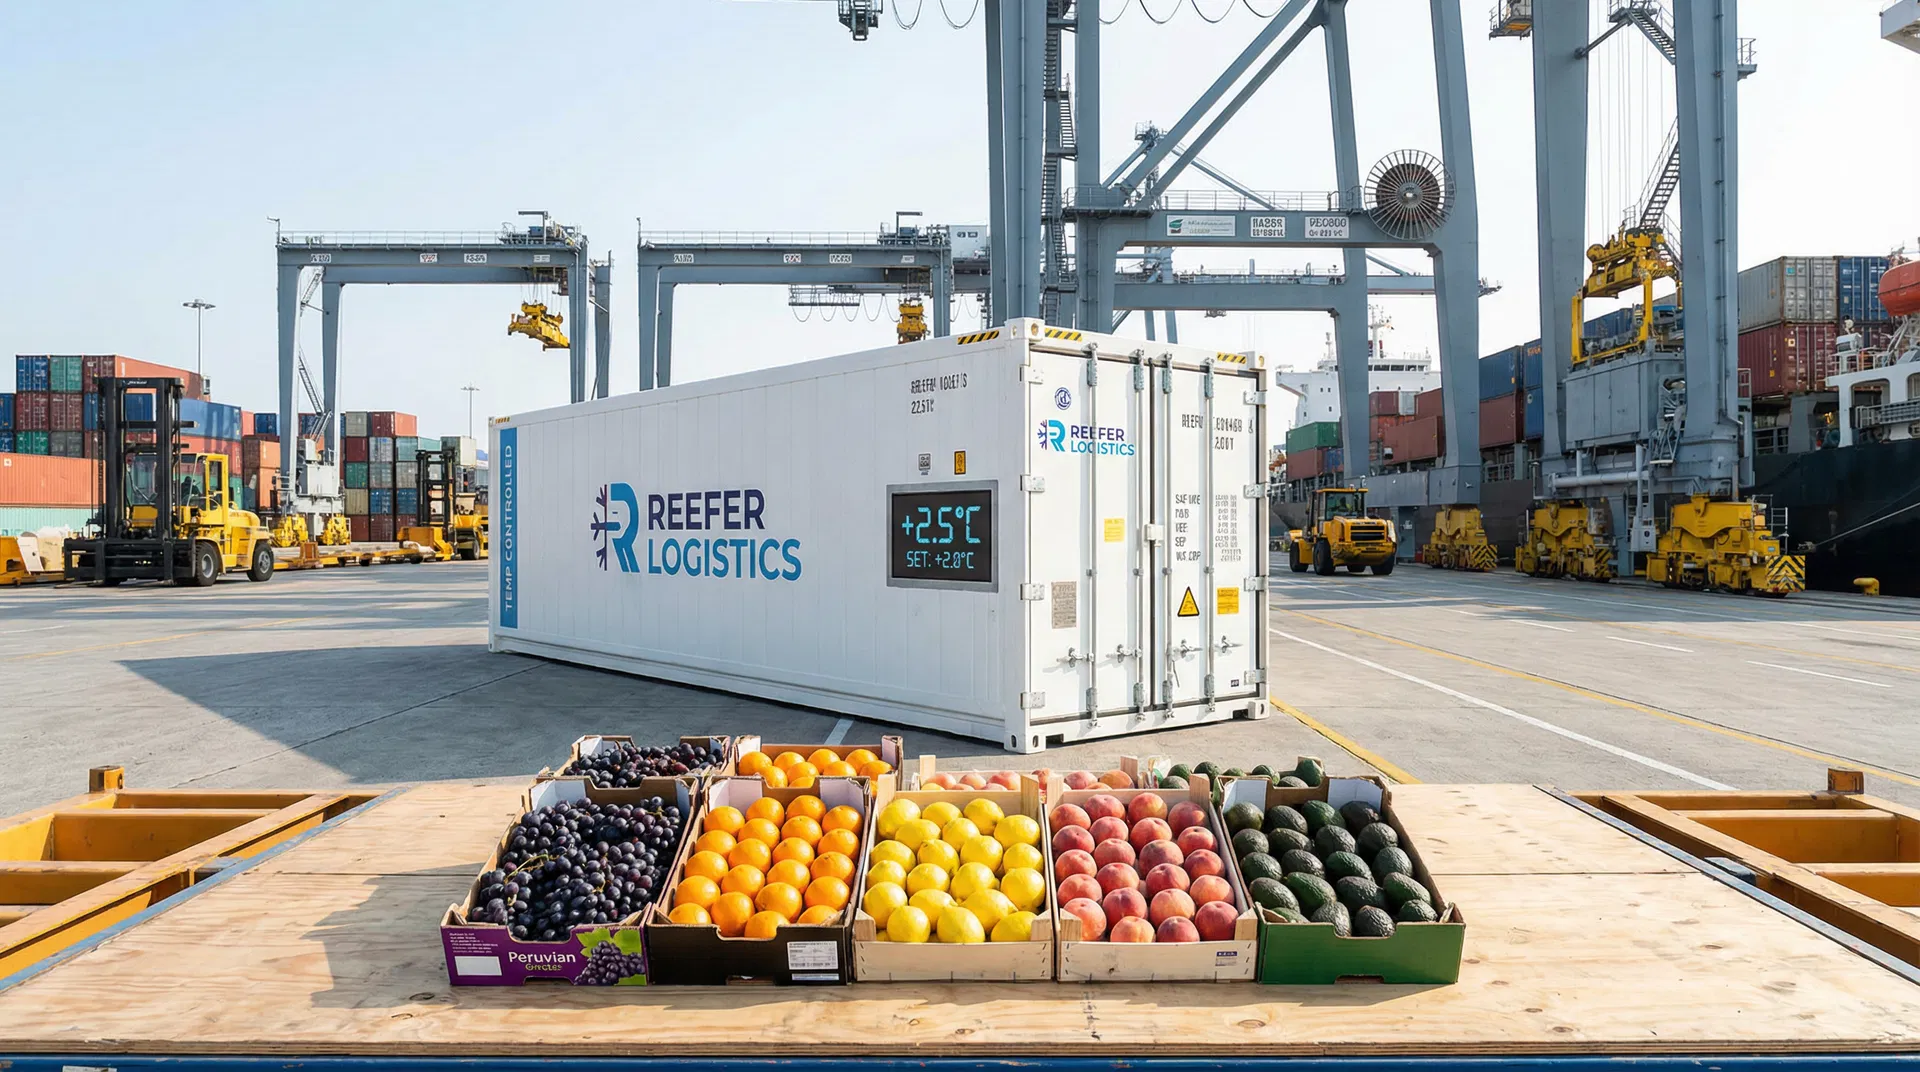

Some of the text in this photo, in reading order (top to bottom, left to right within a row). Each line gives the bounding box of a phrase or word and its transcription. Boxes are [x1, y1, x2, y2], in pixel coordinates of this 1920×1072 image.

[1070, 425, 1125, 441] REEFER
[505, 445, 513, 612] TEMP CONTROLLED
[647, 488, 766, 531] REEFER
[901, 505, 981, 544] +2.5°C
[647, 537, 802, 581] LOGISTICS
[906, 550, 932, 568] SET:
[508, 951, 576, 963] Peruvian
